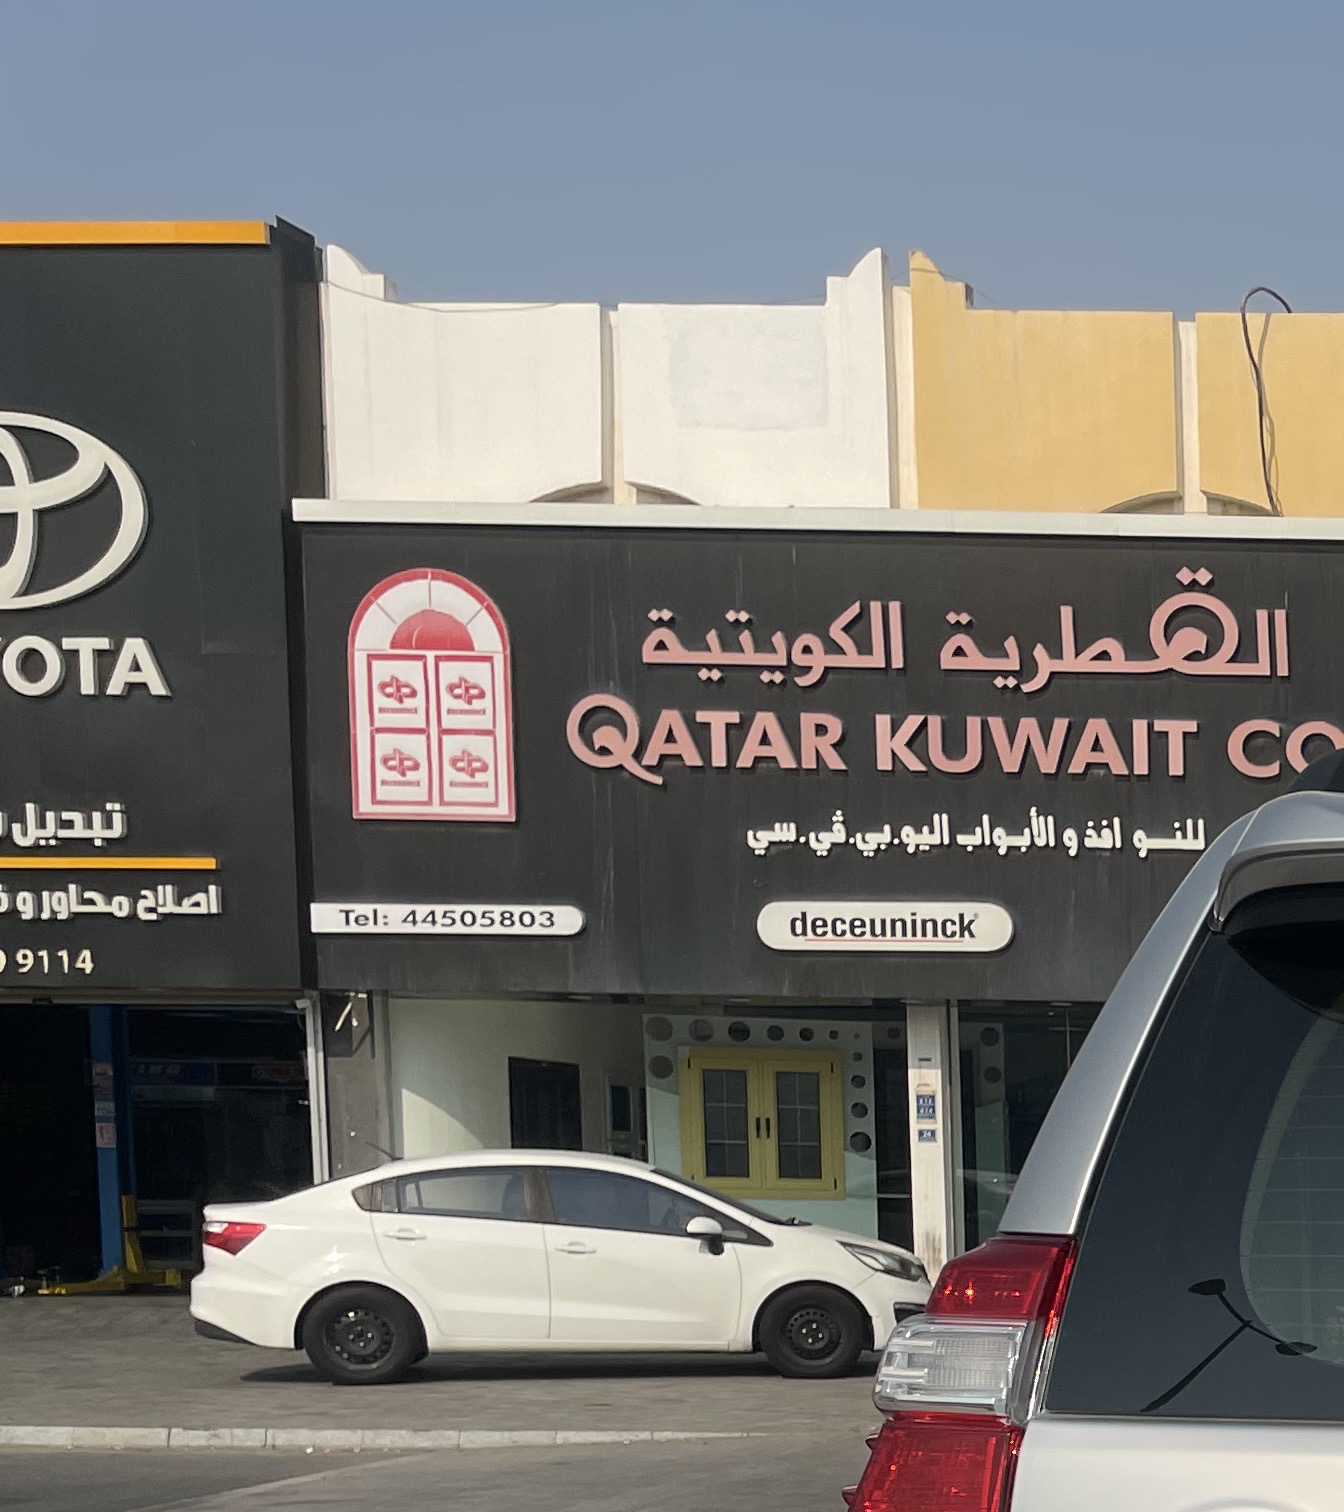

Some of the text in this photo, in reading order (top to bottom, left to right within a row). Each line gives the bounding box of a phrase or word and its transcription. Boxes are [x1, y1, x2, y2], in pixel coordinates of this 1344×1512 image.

[641, 566, 1290, 693] القطرية الكويتية
[0, 635, 172, 697] OTA
[566, 693, 848, 785] QATAR
[874, 712, 1199, 776] KUWAIT
[12, 803, 126, 847] تبديل
[136, 884, 219, 921] اصلاح
[339, 909, 556, 928] Tel: 44505803
[790, 911, 976, 940] deceuninck
[16, 949, 94, 975] 9114
